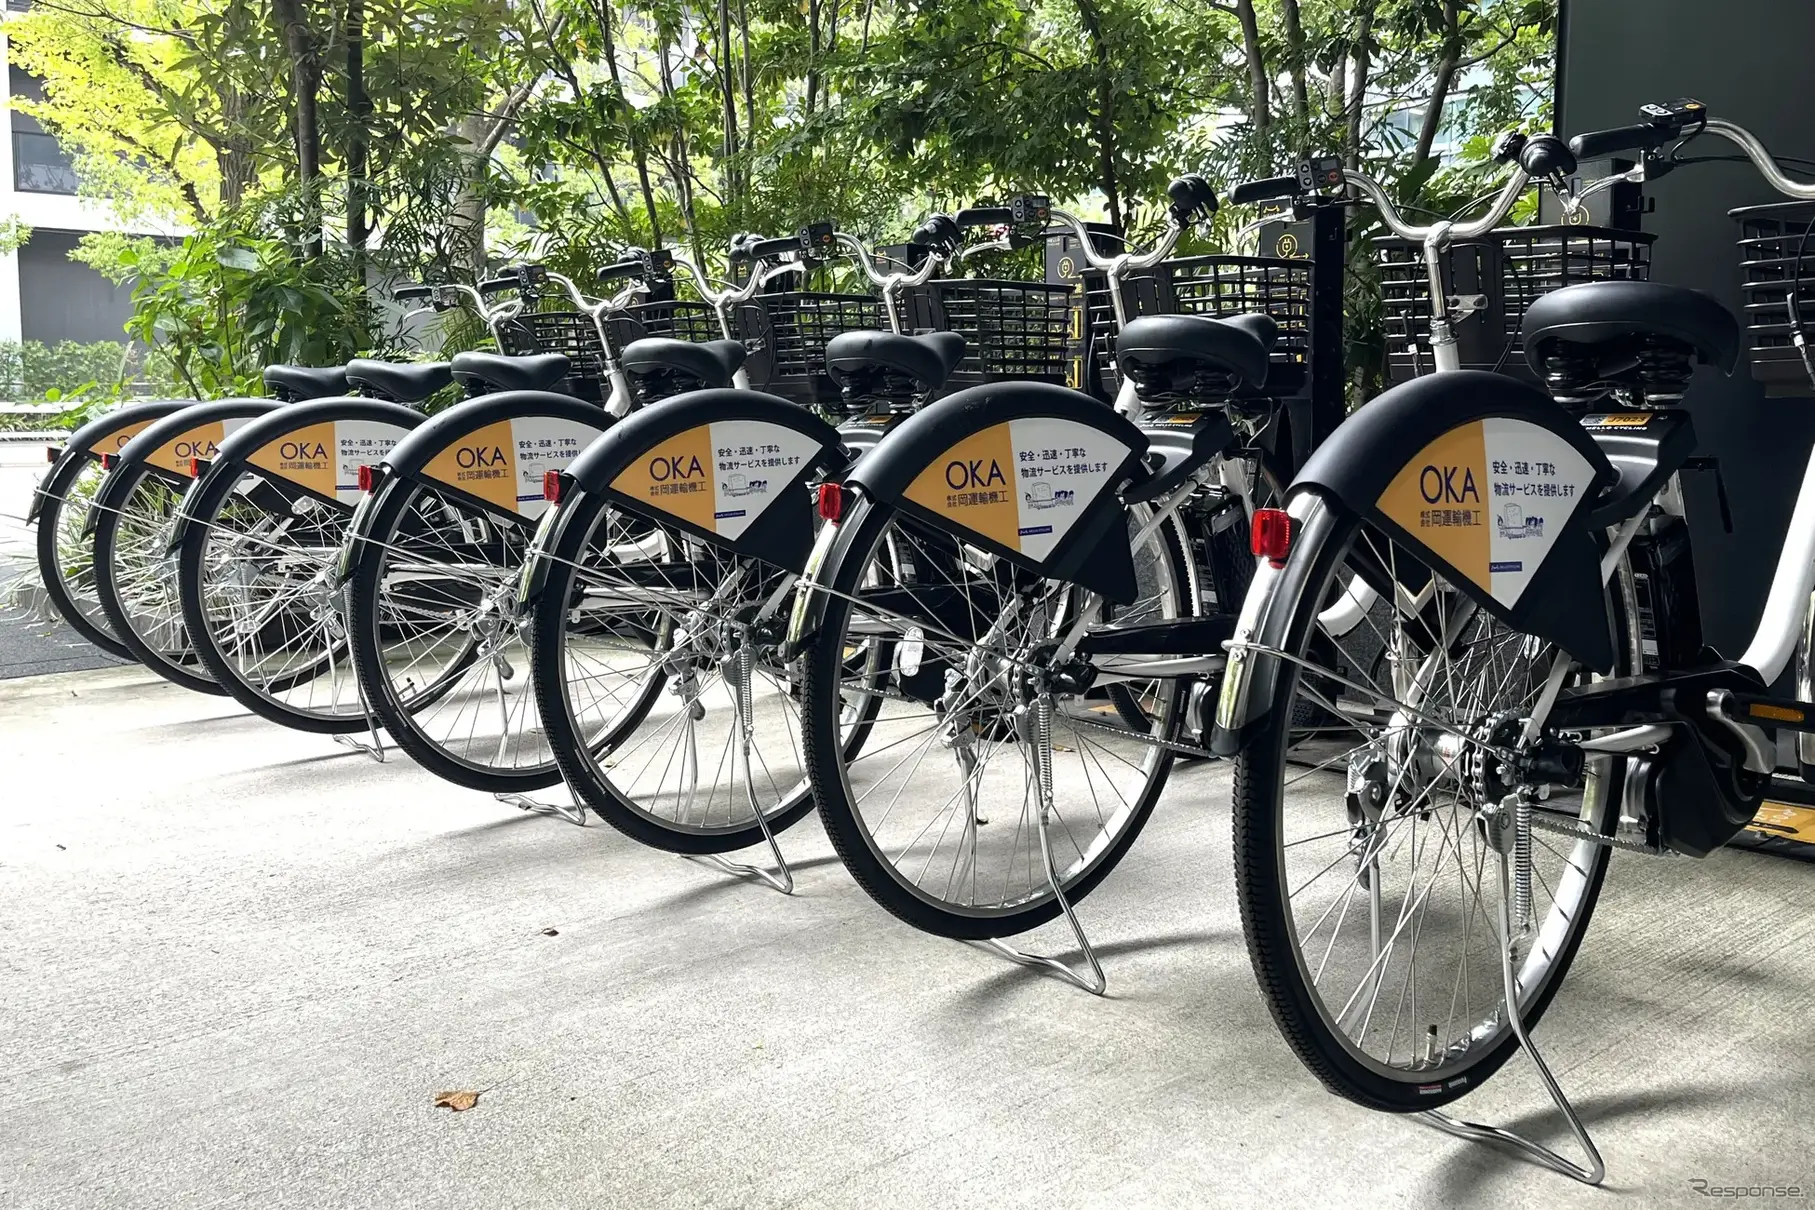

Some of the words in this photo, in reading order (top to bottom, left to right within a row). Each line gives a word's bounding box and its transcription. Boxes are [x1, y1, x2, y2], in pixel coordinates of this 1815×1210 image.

[175, 441, 217, 458] OKA
[280, 442, 328, 460] OKA
[456, 446, 507, 468] OKA
[718, 445, 780, 458] 安全・迅速・丁寧な
[1019, 448, 1087, 462] 安全・迅速・丁寧な
[649, 455, 705, 482] OKA
[718, 456, 801, 471] 物流サービスを提供します
[1020, 462, 1108, 479] 物流サービスを提供します
[1492, 460, 1556, 476] 安全・迅速・丁寧な
[945, 459, 1006, 490] OKA
[1419, 465, 1480, 504] OKA
[1493, 482, 1575, 497] 物流サービスを提供します
